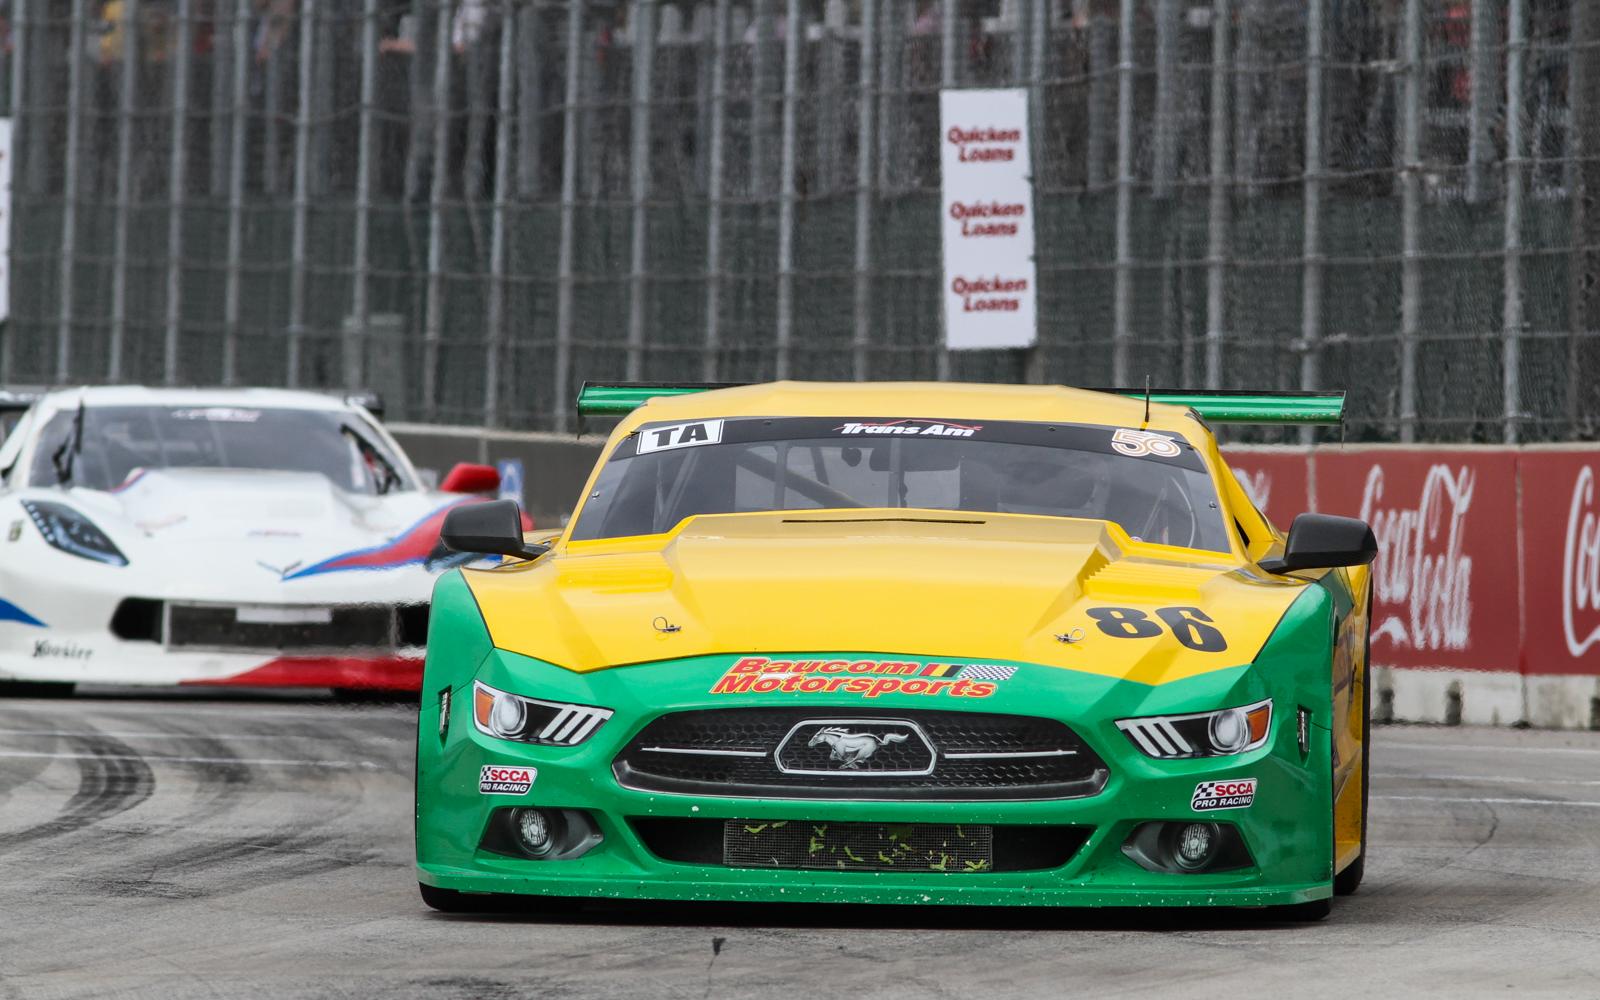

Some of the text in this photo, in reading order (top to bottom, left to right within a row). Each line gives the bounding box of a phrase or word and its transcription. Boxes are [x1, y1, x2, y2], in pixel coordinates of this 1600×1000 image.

[948, 126, 1021, 144] Quicken
[959, 147, 1014, 162] Loans
[950, 201, 1025, 219] Quicken
[962, 221, 1018, 237] Loans
[952, 275, 1028, 294] Quicken
[963, 297, 1019, 312] Loans
[651, 423, 708, 447] TA
[1085, 606, 1228, 653] 86
[728, 657, 920, 676] Baucom
[709, 674, 998, 699] Motorsports
[490, 769, 530, 783] SCCA
[480, 782, 528, 792] PRO RACING
[1215, 783, 1254, 796] SCCA
[1194, 796, 1252, 808] PRO RACING
